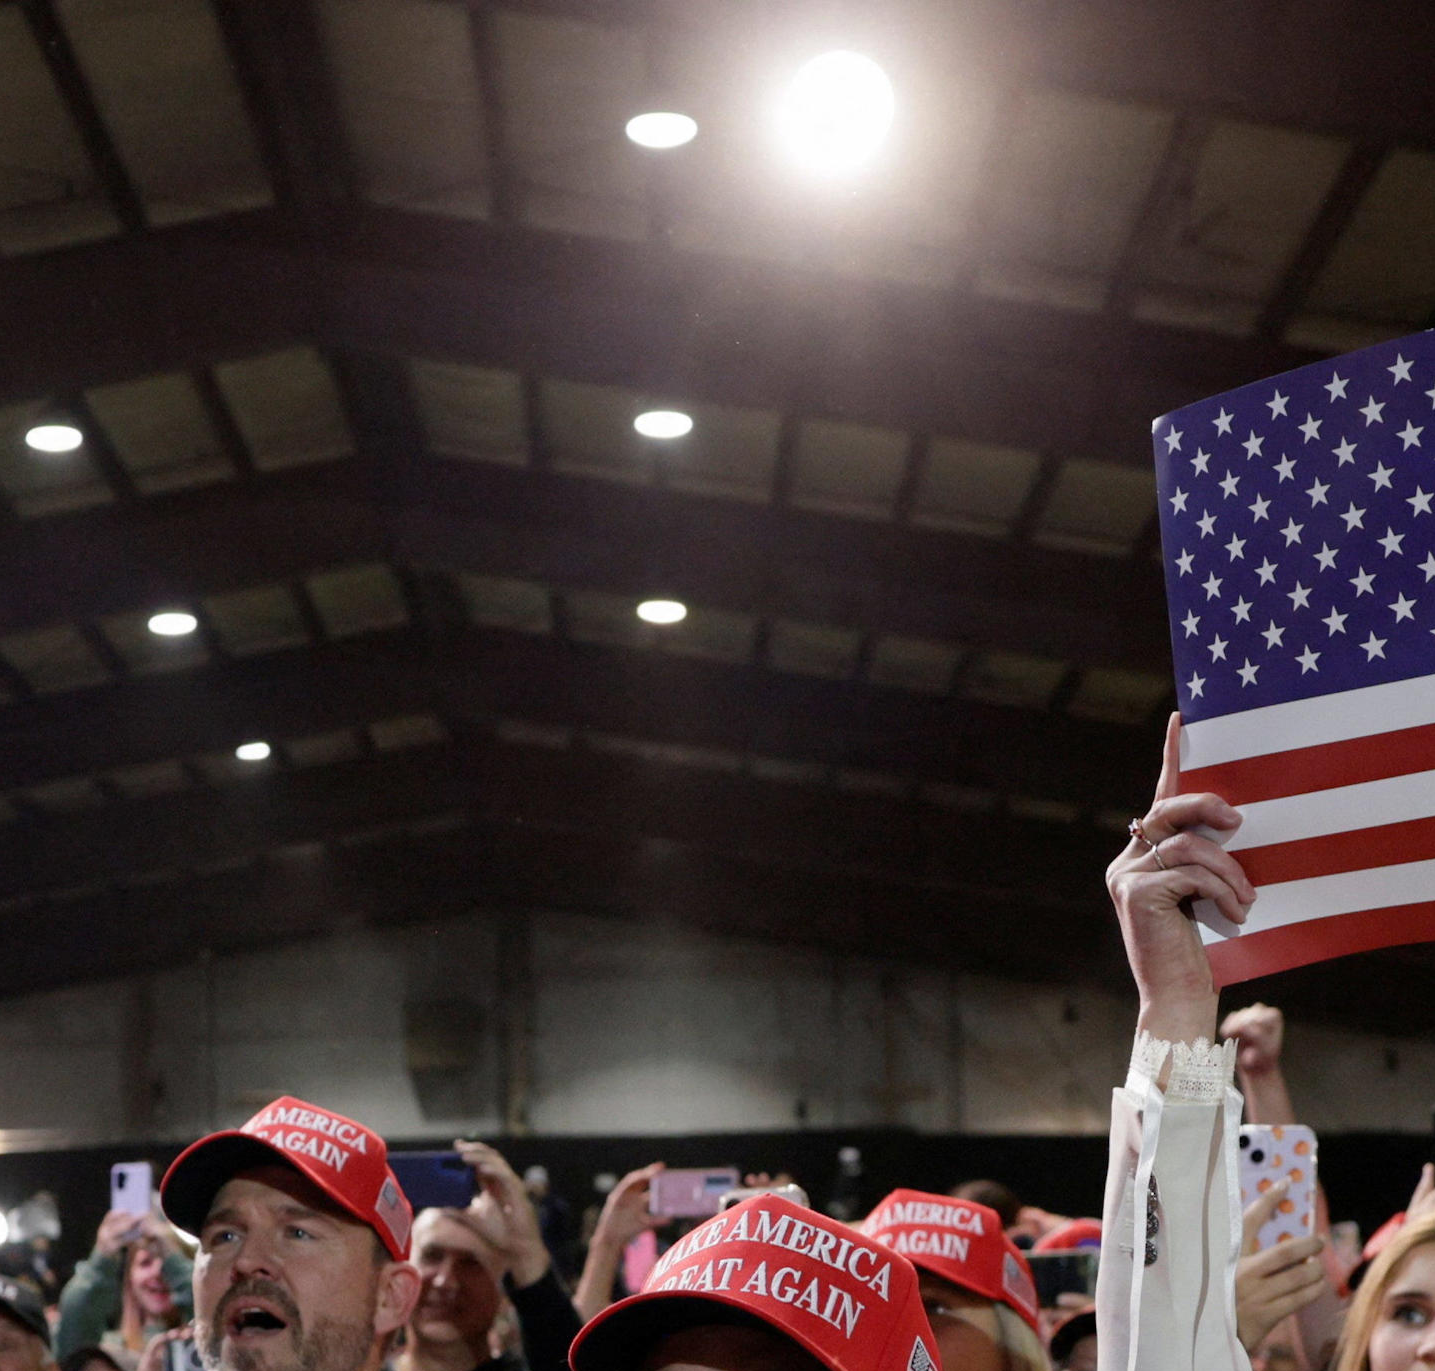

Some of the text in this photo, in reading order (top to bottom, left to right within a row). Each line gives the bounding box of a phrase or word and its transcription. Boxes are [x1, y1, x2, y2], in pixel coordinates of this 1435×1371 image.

[259, 1106, 367, 1155] AMERICA
[269, 1129, 350, 1173] AGAIN
[879, 1200, 985, 1237] AMERICA
[647, 1209, 892, 1302] MAKE AMERICA
[893, 1229, 970, 1264] AGAIN
[655, 1257, 865, 1340] REAT AGAIN
